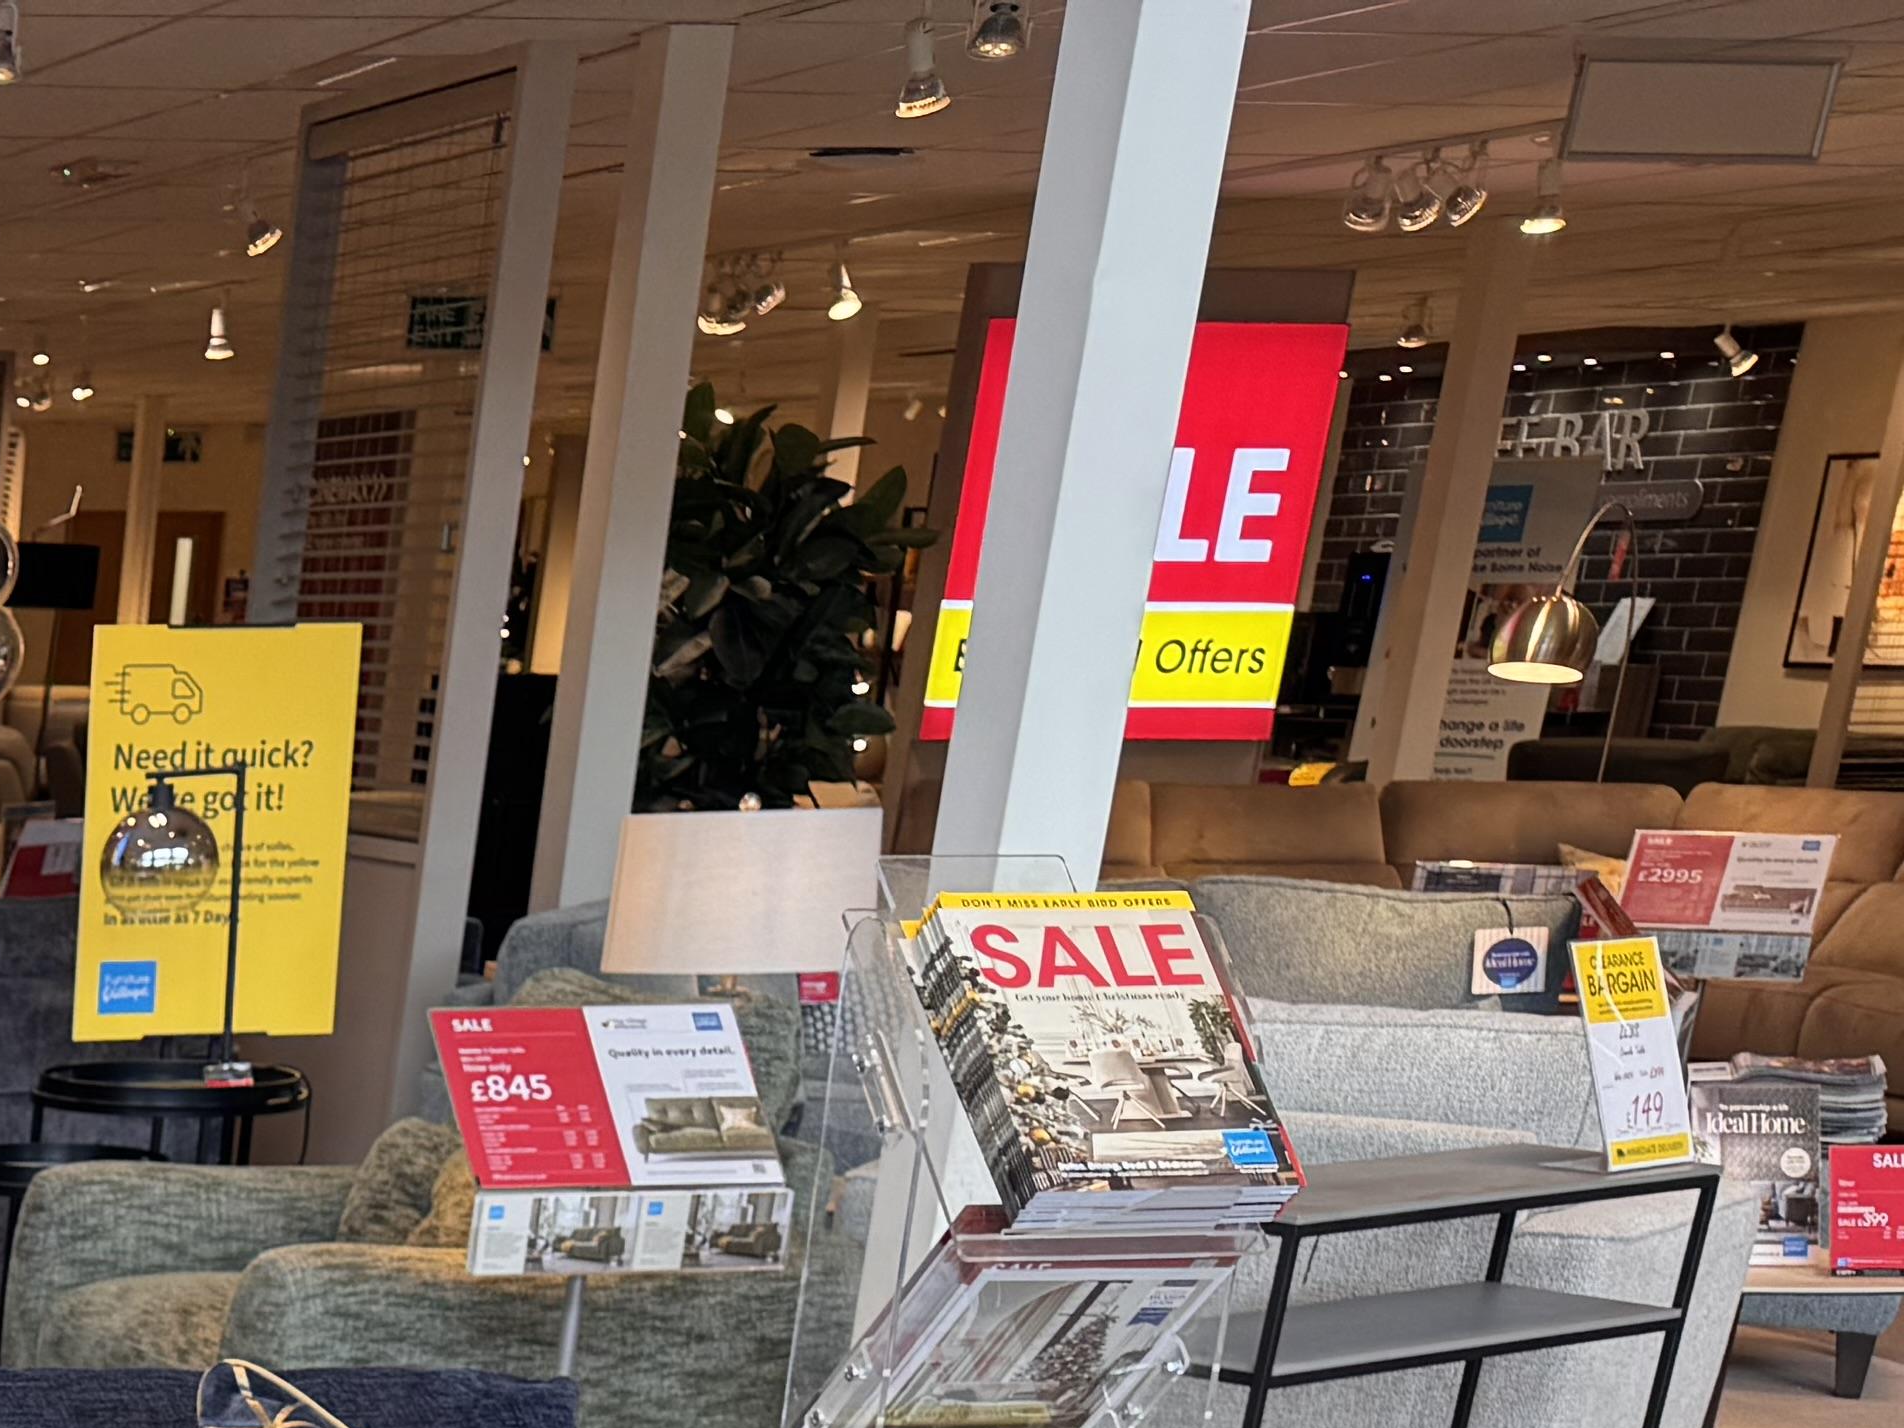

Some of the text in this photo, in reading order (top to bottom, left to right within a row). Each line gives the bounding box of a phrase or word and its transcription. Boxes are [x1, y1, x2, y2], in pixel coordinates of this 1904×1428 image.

[1553, 408, 1650, 472] BAR
[1153, 447, 1291, 562] LE
[1155, 638, 1267, 675] Offers
[114, 740, 187, 771] Need
[195, 741, 213, 770] it
[255, 783, 284, 811] it!
[1638, 868, 1704, 885] £2995
[1007, 899, 1039, 909] MISS
[1044, 899, 1082, 909] EARLY
[1123, 897, 1172, 908] OFFERS
[969, 923, 1205, 988] SALE
[451, 1018, 493, 1032] SALE
[608, 1047, 649, 1060] Quality
[652, 1047, 663, 1056] in
[665, 1048, 697, 1058] every
[470, 1074, 553, 1102] £845
[1705, 1111, 1807, 1134] Ideal Home
